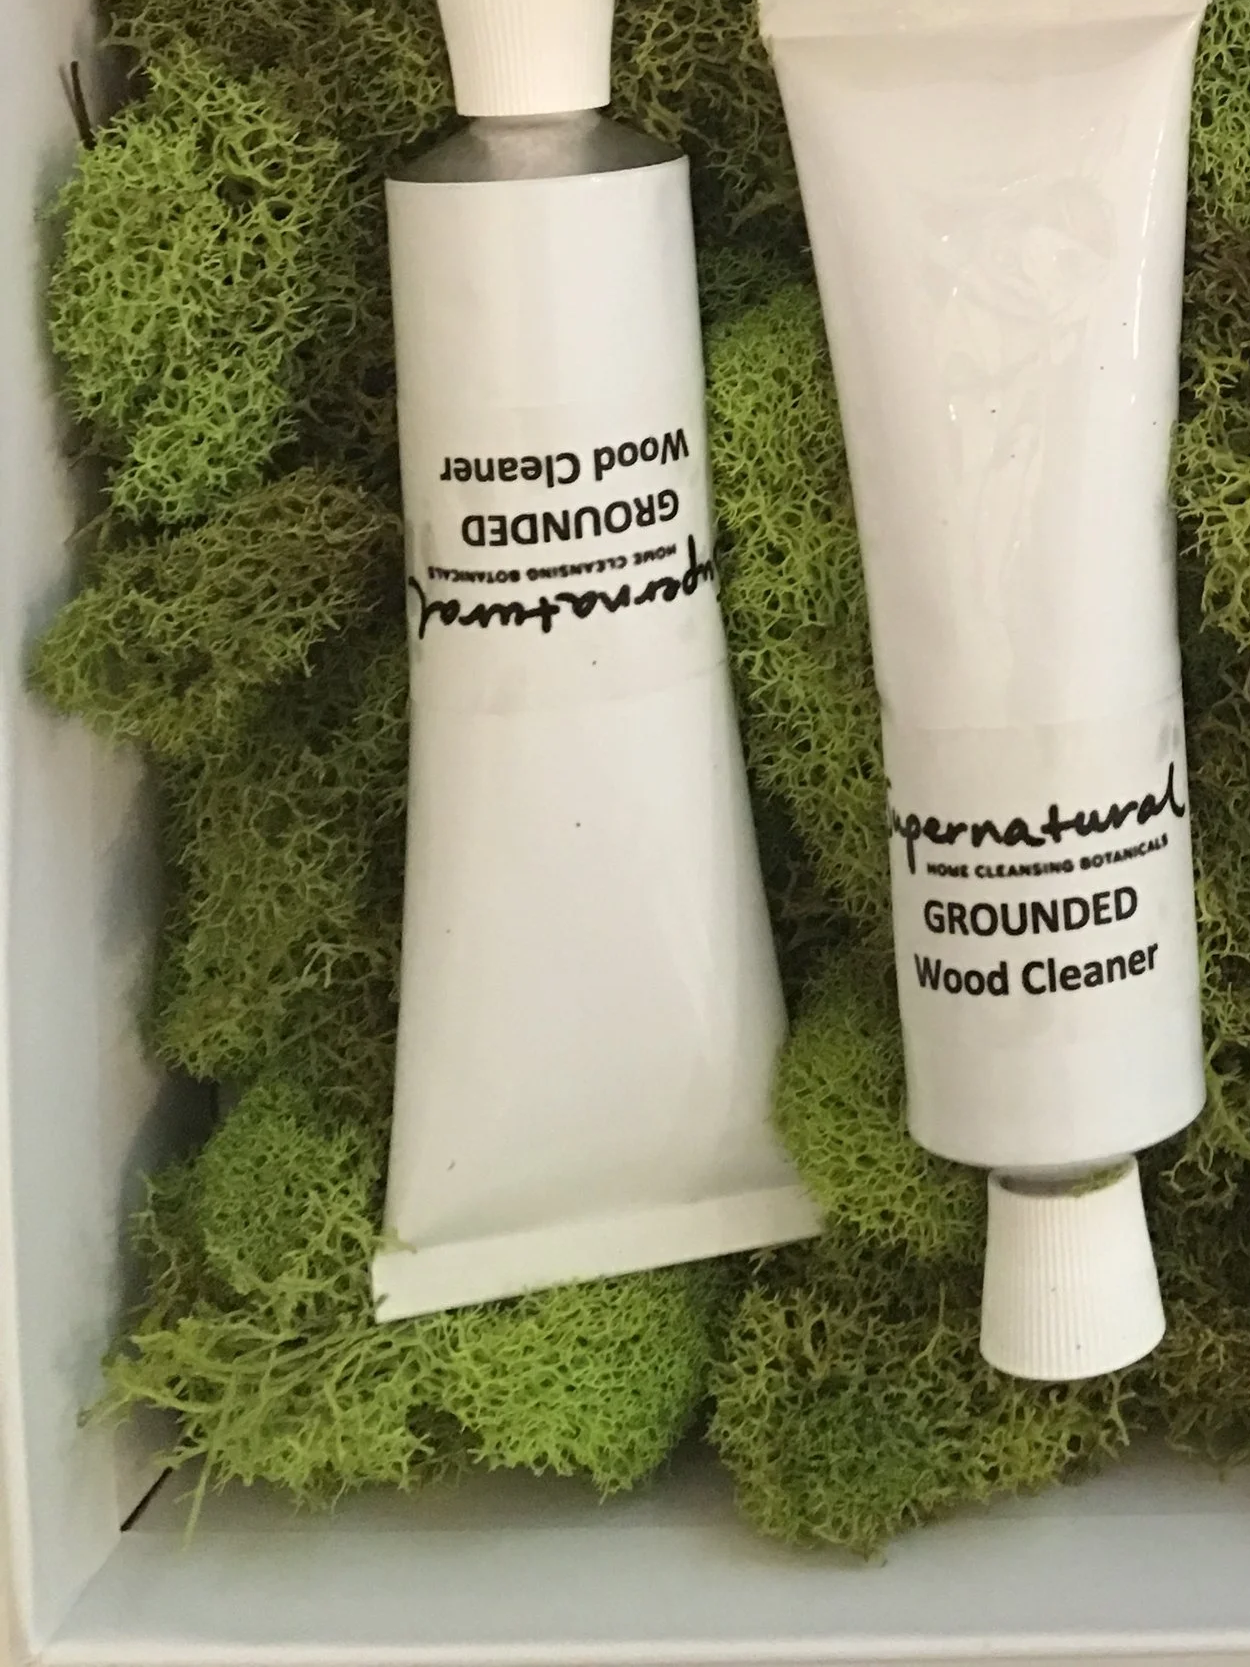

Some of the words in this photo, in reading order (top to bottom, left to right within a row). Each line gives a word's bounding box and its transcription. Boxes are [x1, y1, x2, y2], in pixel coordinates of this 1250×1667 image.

[439, 452, 580, 488] Cleaner
[594, 429, 690, 481] Wood
[461, 489, 679, 547] GROUNDED
[526, 556, 627, 582] CLEANSING
[632, 543, 677, 565] HOME
[408, 534, 721, 640] upernatural
[885, 761, 1186, 875] upernatural
[927, 863, 969, 878] HOME
[974, 859, 1075, 879] CLEANSING
[1079, 832, 1169, 870] BOTANICALS
[923, 886, 1138, 936] GROUNDED
[914, 953, 1009, 996] Wood
[1020, 943, 1158, 997] Cleaner
